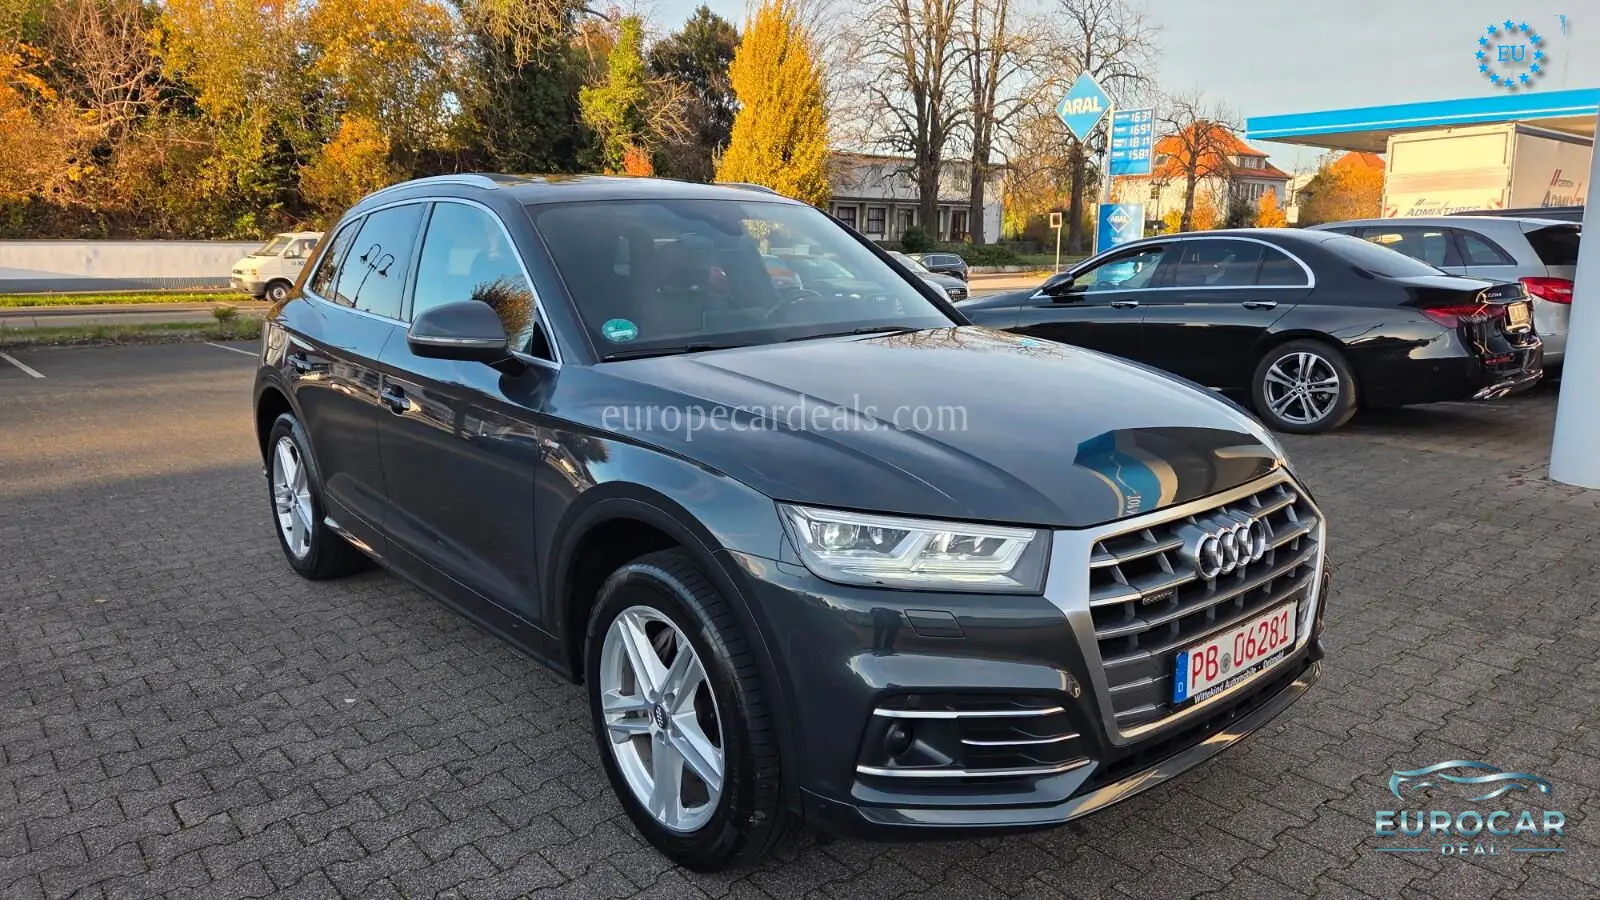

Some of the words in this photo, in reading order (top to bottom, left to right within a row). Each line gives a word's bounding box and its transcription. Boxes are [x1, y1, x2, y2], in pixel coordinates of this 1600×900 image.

[1062, 96, 1102, 116] ARAL
[1191, 645, 1219, 689] PB
[1233, 611, 1288, 667] 06281
[1177, 681, 1184, 693] D
